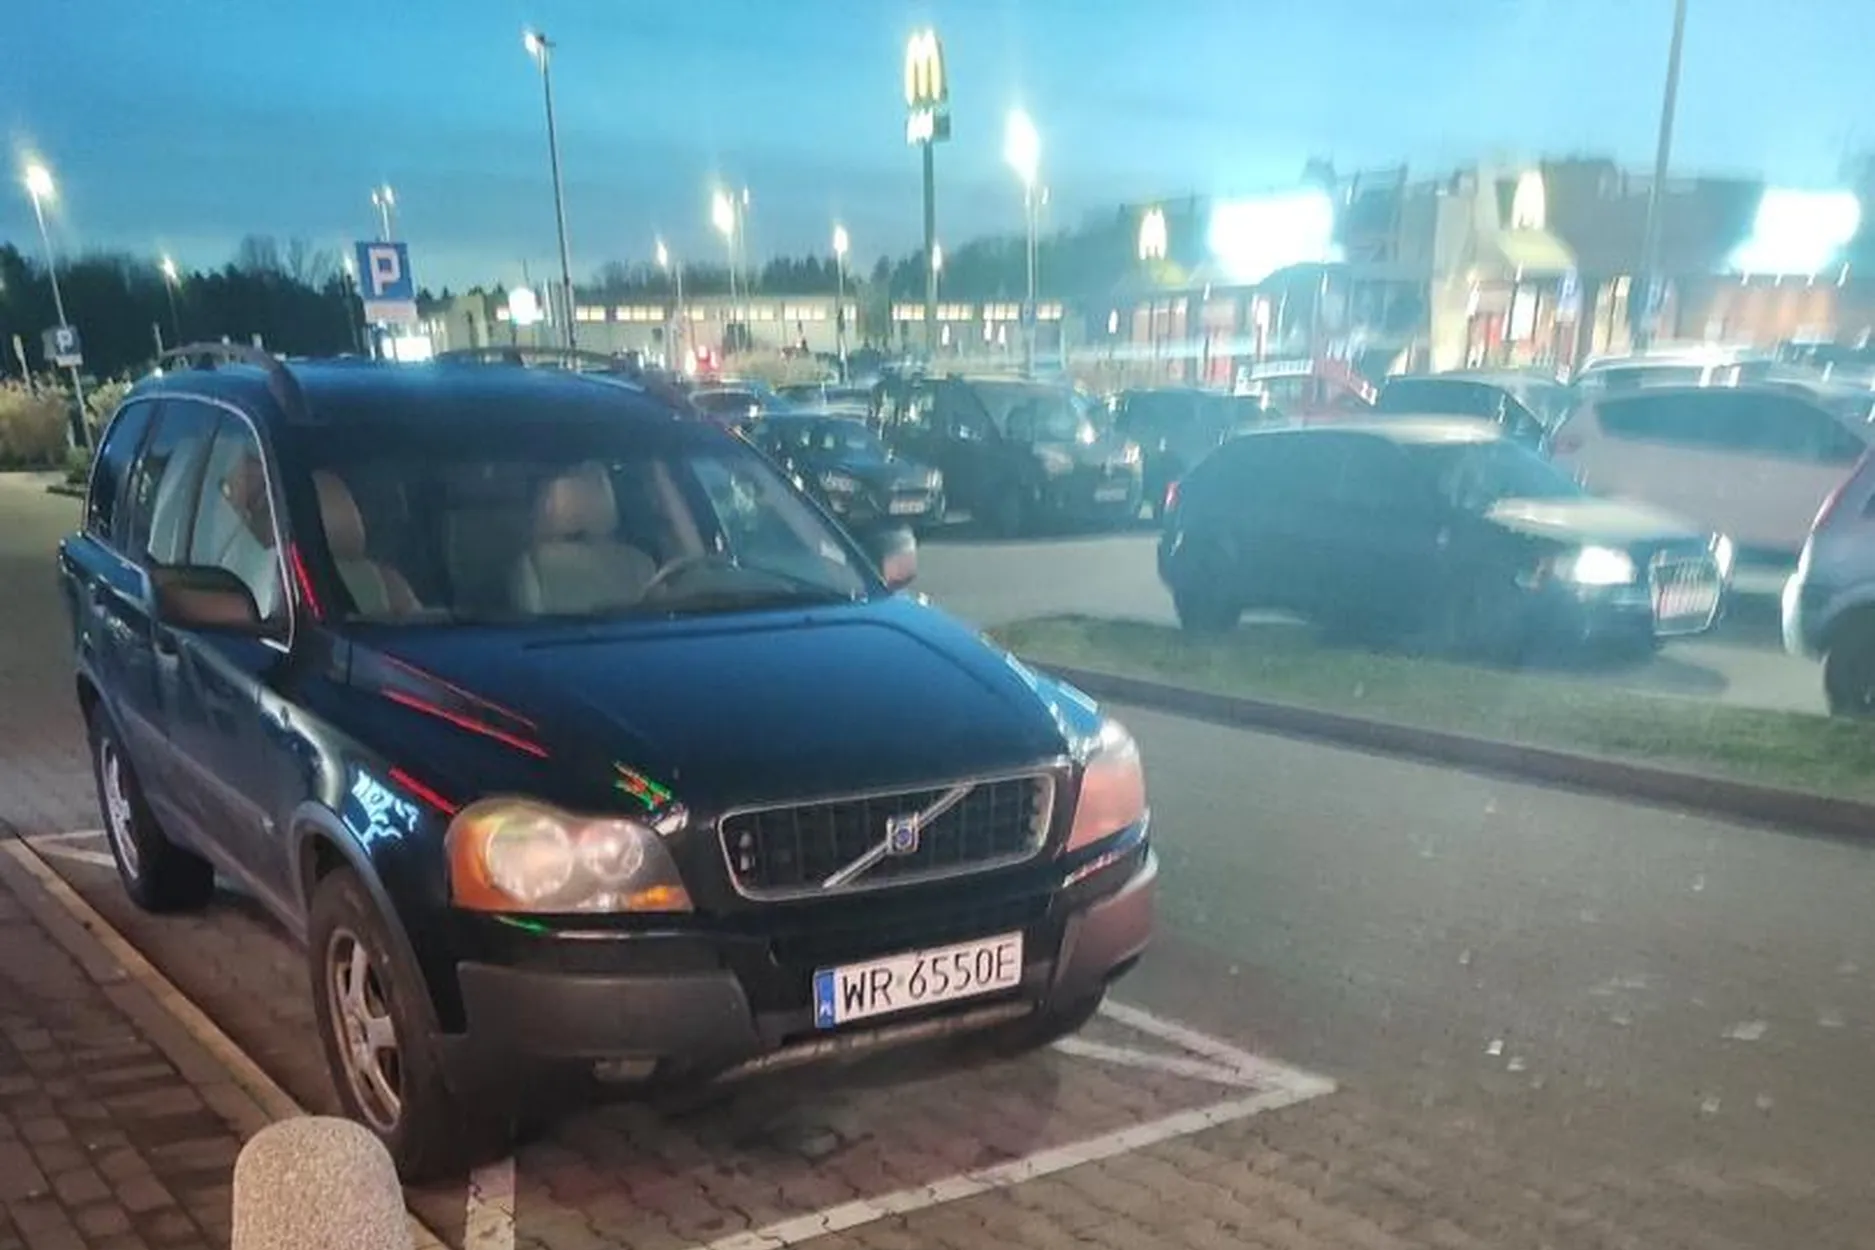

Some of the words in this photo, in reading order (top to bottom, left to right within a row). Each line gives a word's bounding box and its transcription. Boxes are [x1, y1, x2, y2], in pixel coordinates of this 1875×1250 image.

[368, 248, 401, 296] P
[56, 329, 73, 353] P
[842, 967, 894, 1014] WR
[908, 942, 1016, 1001] 6550E
